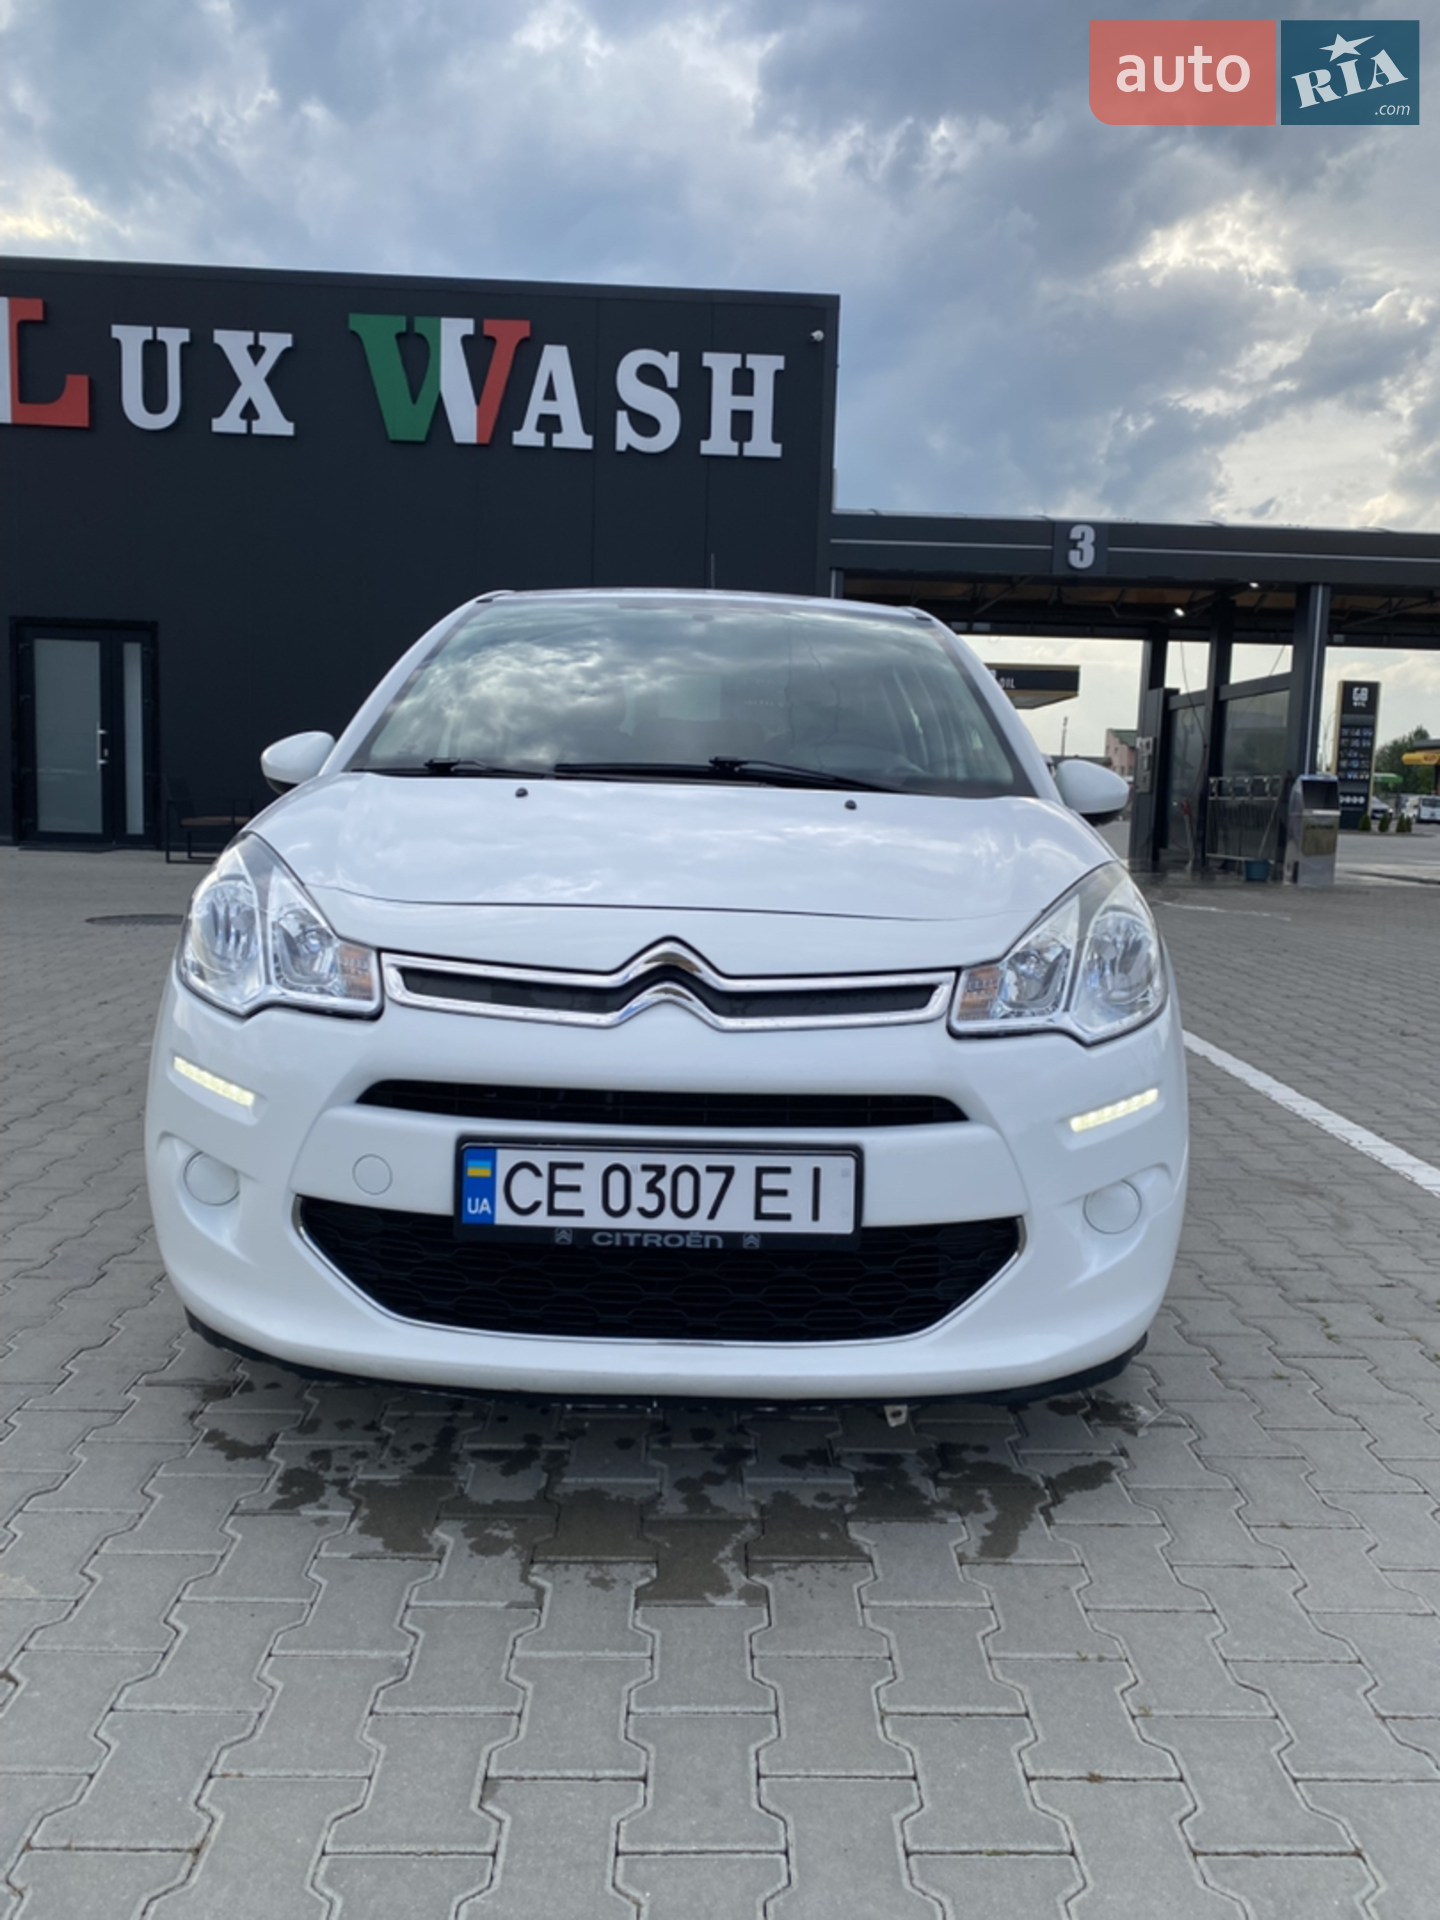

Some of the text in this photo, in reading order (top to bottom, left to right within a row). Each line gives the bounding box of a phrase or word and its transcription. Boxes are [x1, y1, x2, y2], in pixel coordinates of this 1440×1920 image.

[0, 297, 786, 458] LUX WASH
[1068, 523, 1096, 569] 3
[467, 1197, 492, 1215] UA
[503, 1160, 585, 1217] CE
[601, 1163, 736, 1220] 0307
